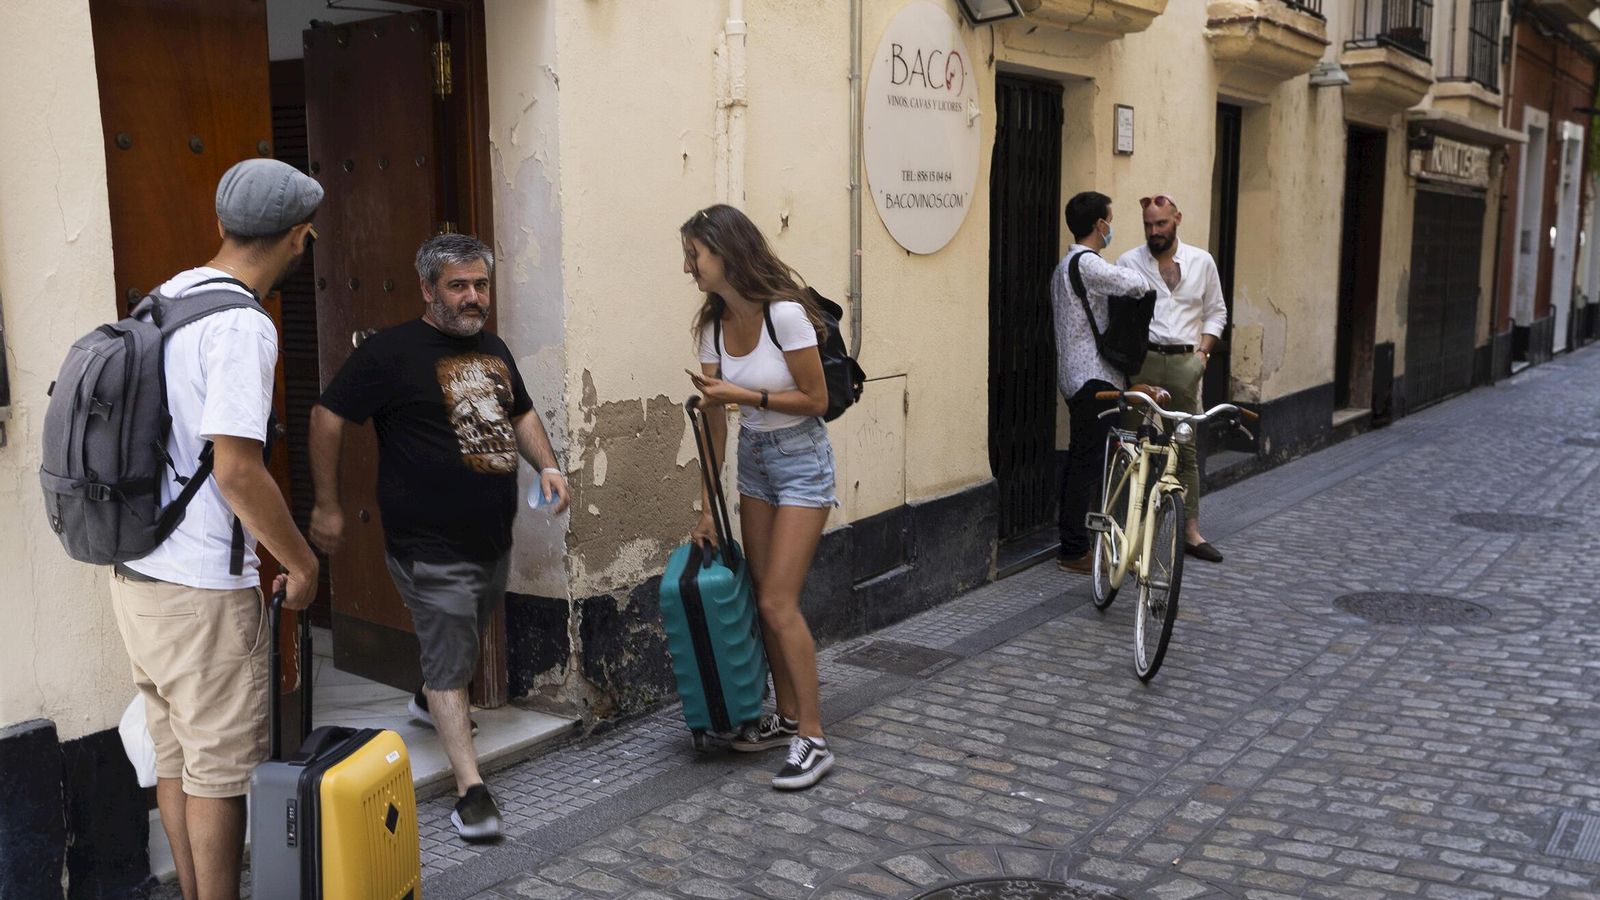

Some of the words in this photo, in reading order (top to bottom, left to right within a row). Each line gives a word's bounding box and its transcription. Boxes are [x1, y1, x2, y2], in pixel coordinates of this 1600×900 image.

[890, 43, 964, 97] BACO
[909, 97, 931, 110] CAVAS
[932, 99, 937, 110] Y
[938, 100, 963, 113] LICORES
[917, 171, 929, 182] 856
[929, 171, 935, 182] 15
[936, 171, 943, 182] 04
[944, 171, 951, 182] 64
